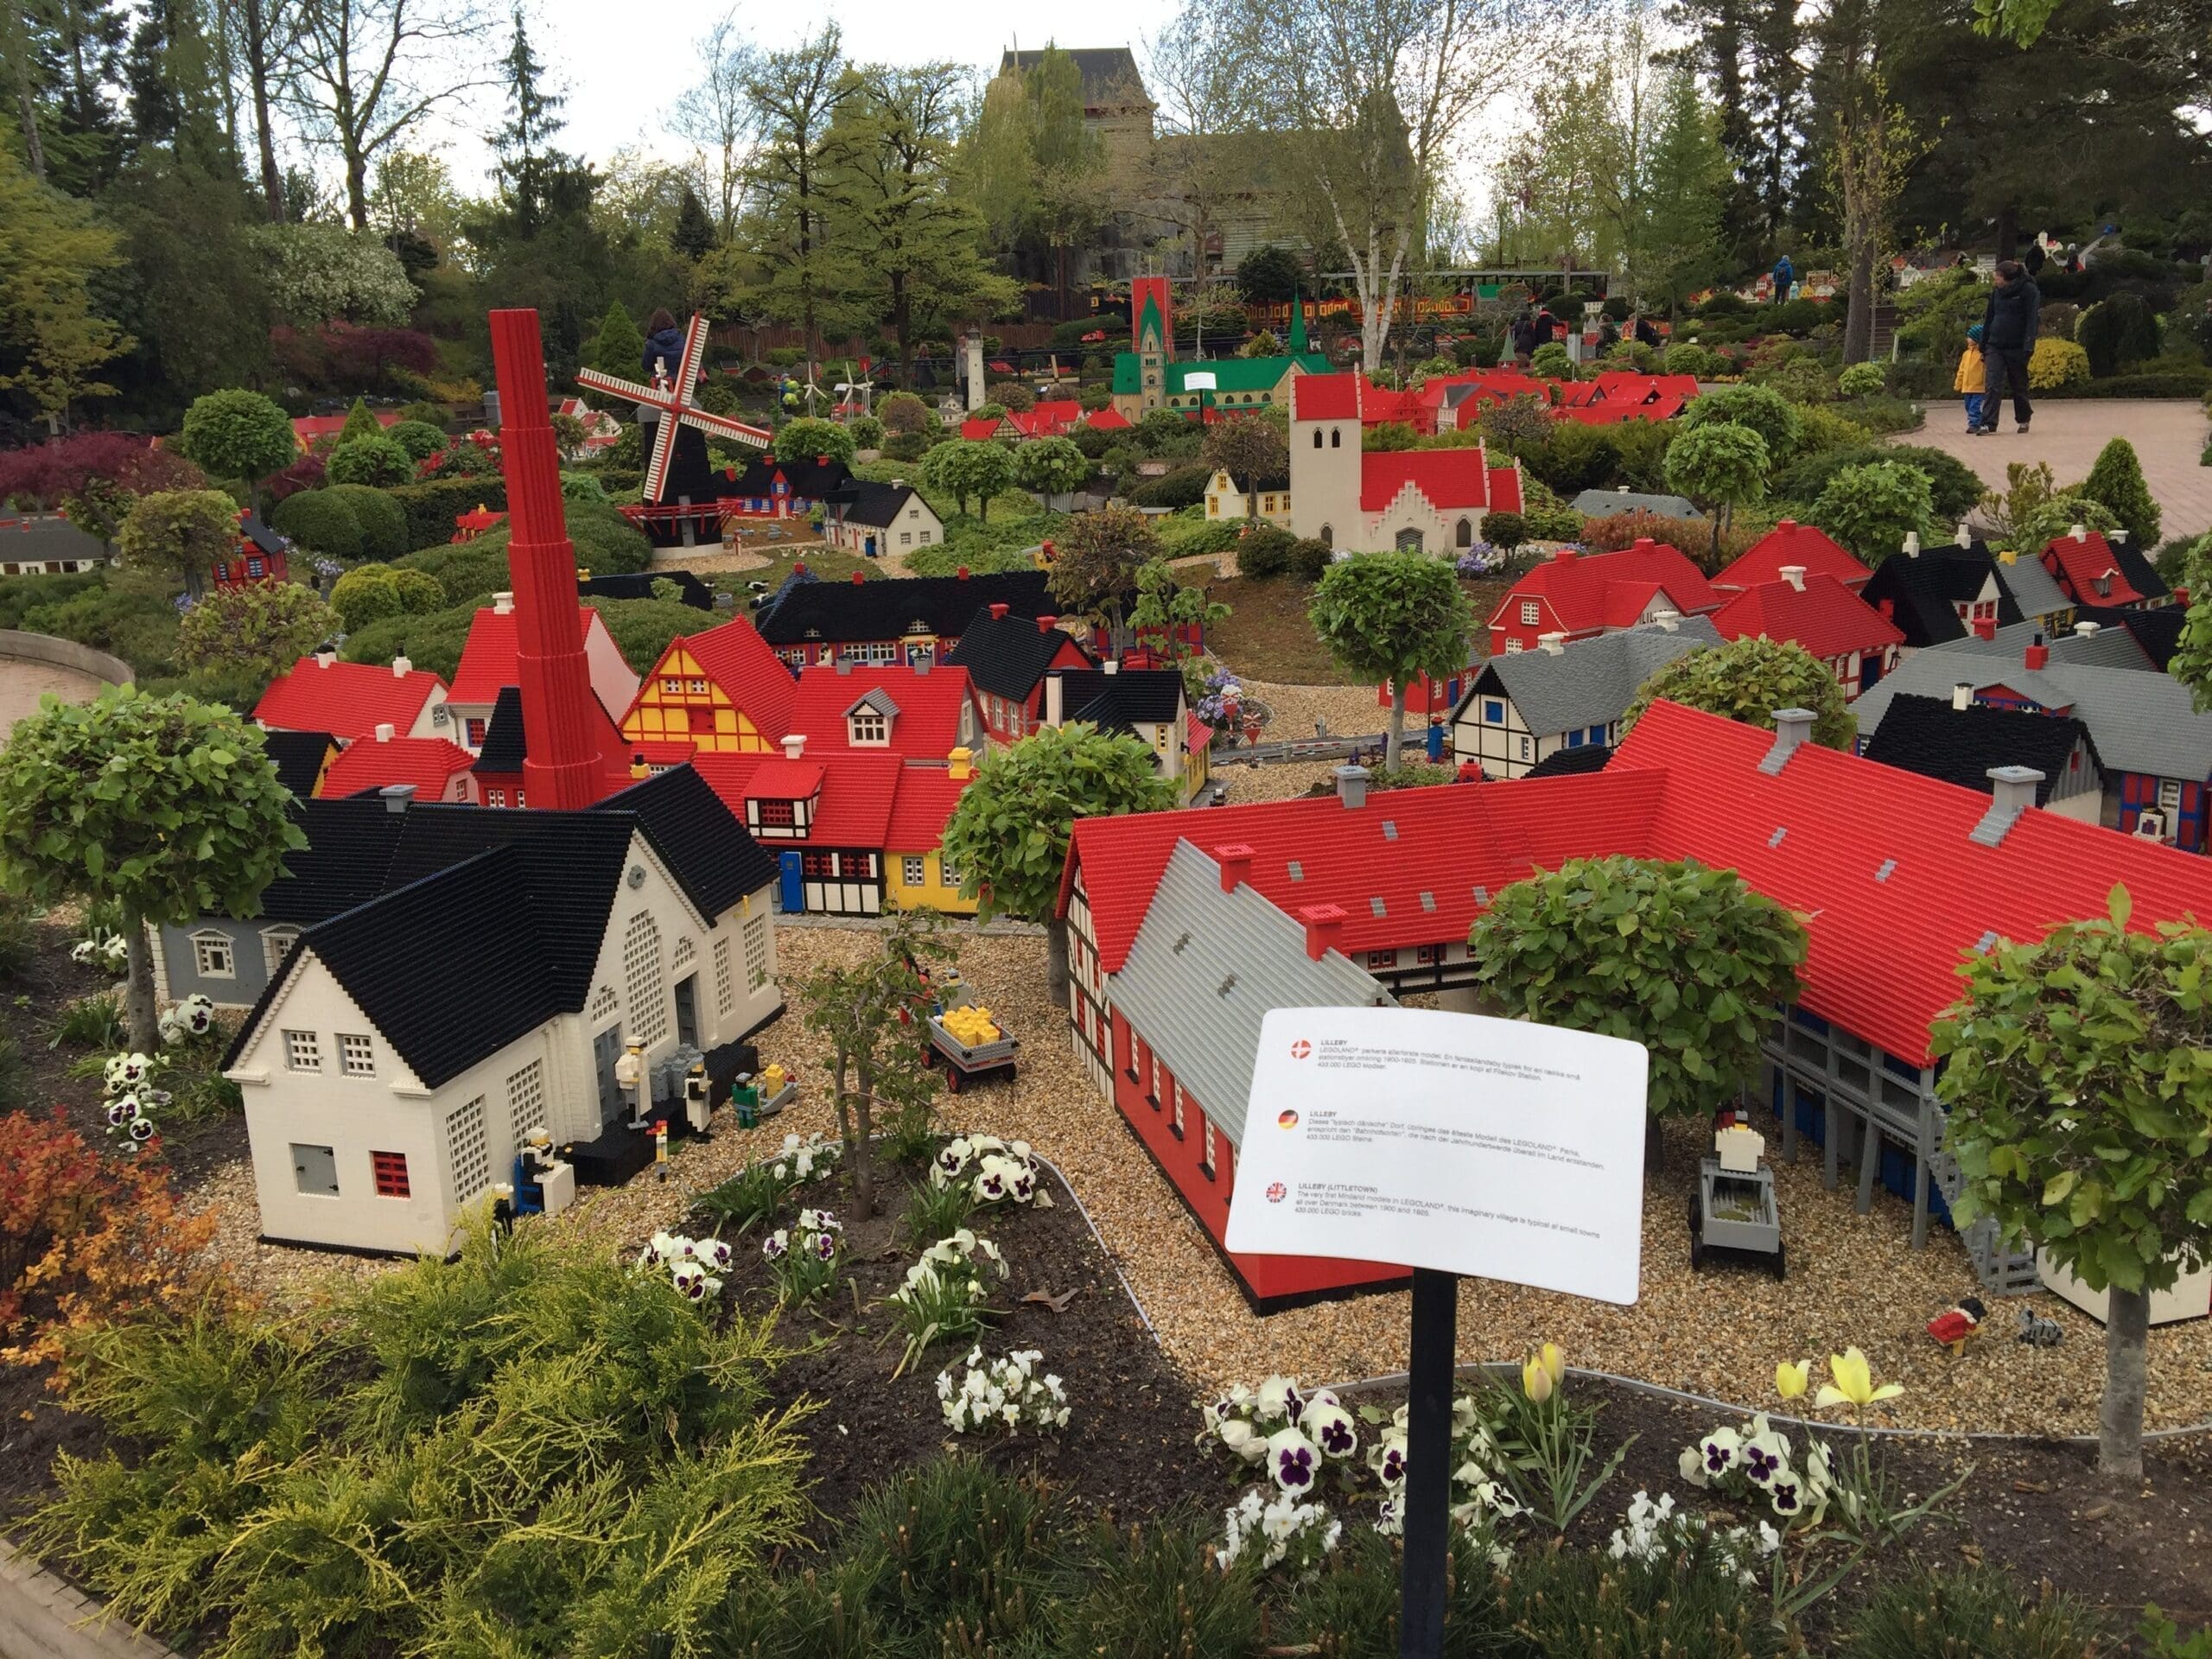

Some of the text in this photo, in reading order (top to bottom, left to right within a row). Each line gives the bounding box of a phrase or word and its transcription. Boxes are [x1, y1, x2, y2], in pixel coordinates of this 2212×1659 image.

[1327, 1184, 1378, 1194] (LITTLETOWN)
[1496, 1213, 1518, 1223] village
[1527, 1218, 1550, 1228] typical
